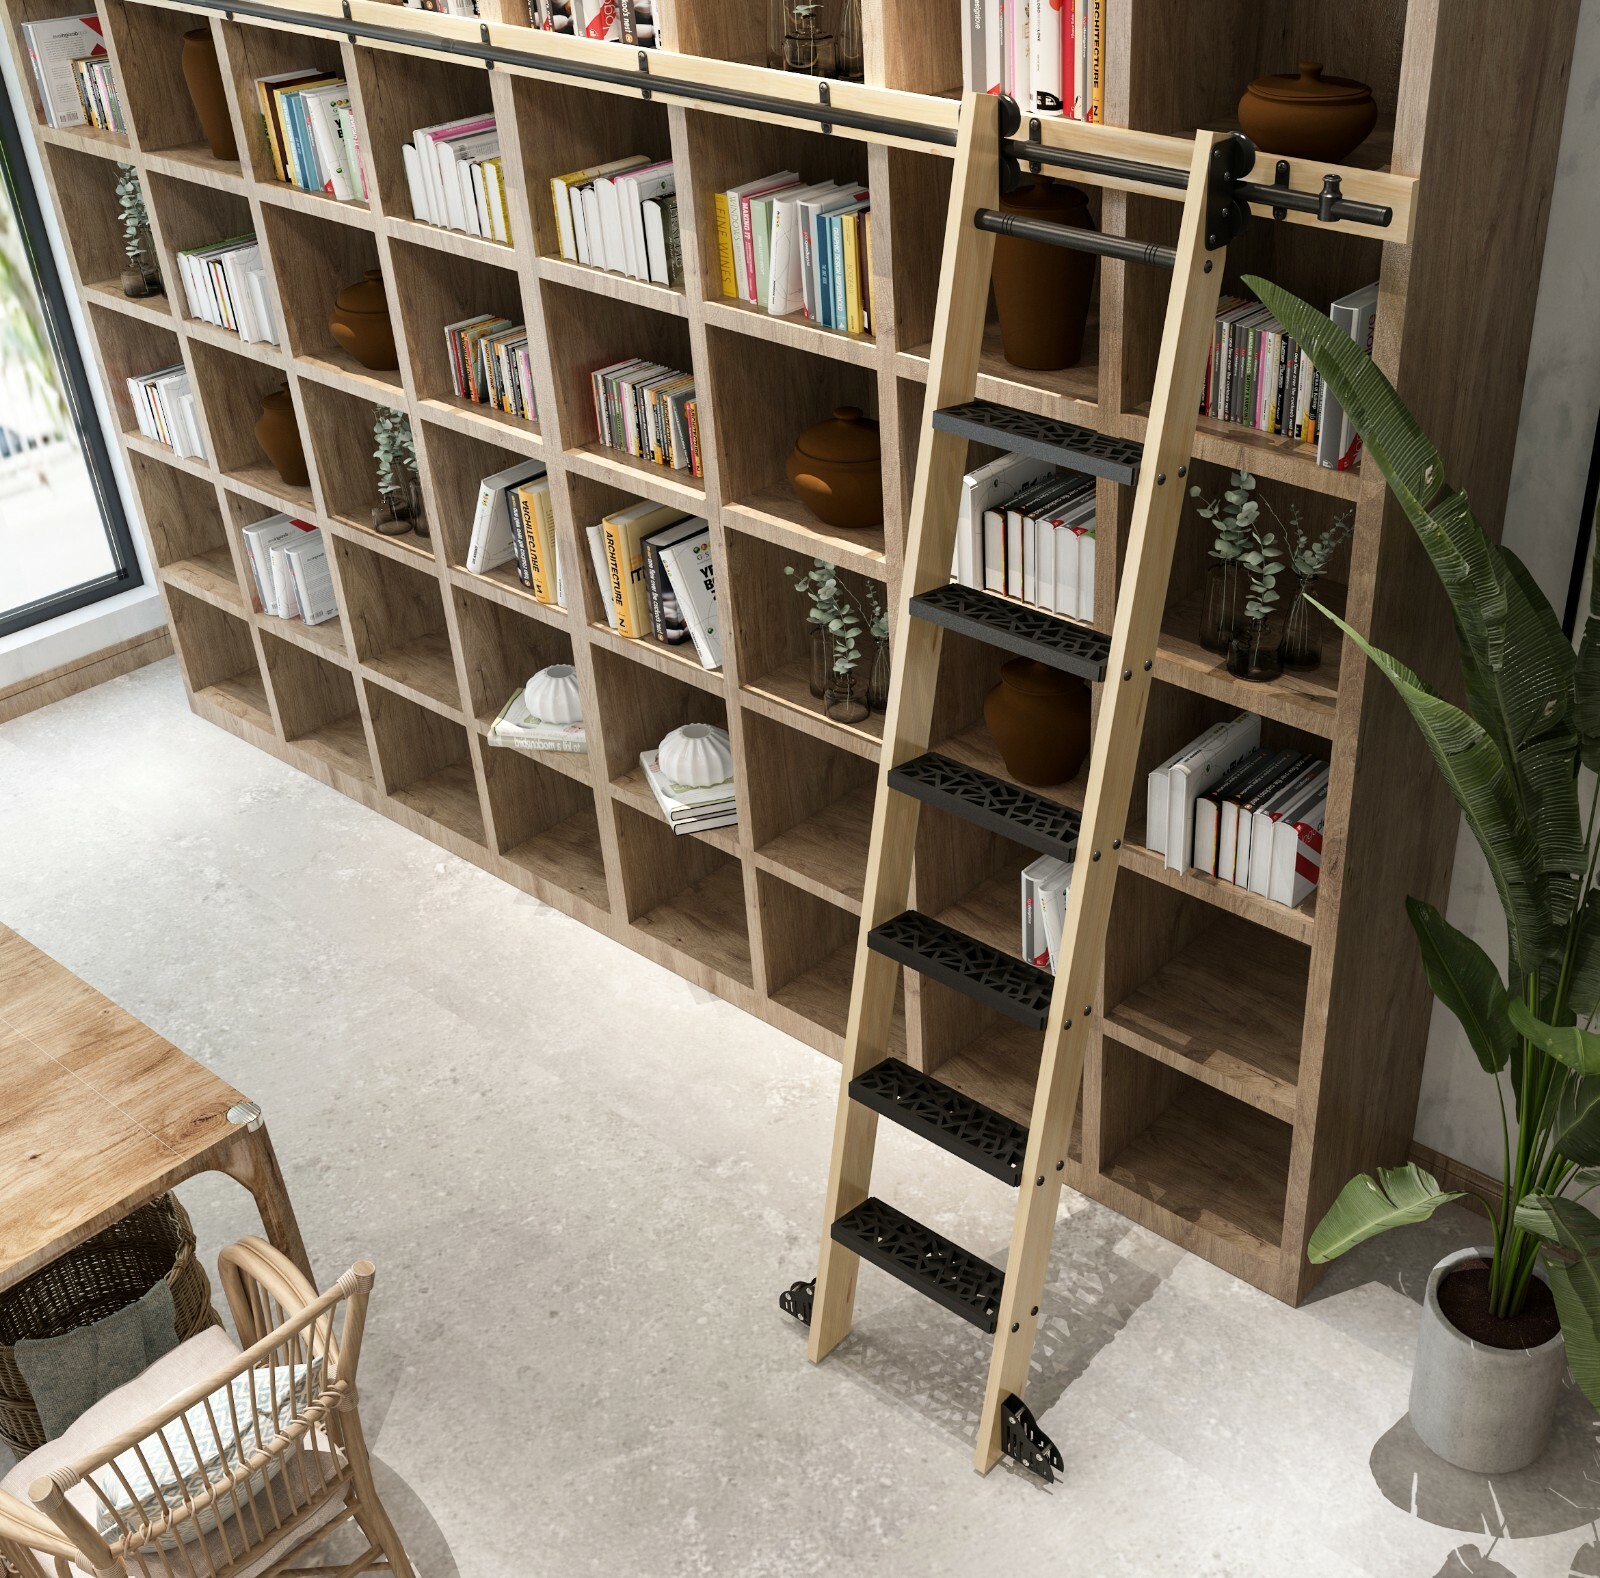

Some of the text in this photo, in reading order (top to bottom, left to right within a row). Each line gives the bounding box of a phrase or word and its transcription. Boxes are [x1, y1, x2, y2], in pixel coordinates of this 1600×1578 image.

[728, 195, 741, 241] WINDOWS
[741, 202, 750, 230] MAKING
[715, 207, 731, 283] FINE WINES
[744, 231, 751, 239] IT
[832, 226, 840, 252] GRAPHIC
[835, 274, 843, 311] REFERENCED
[605, 530, 625, 627] ARCHITECTURE N
[655, 622, 663, 634] nest
